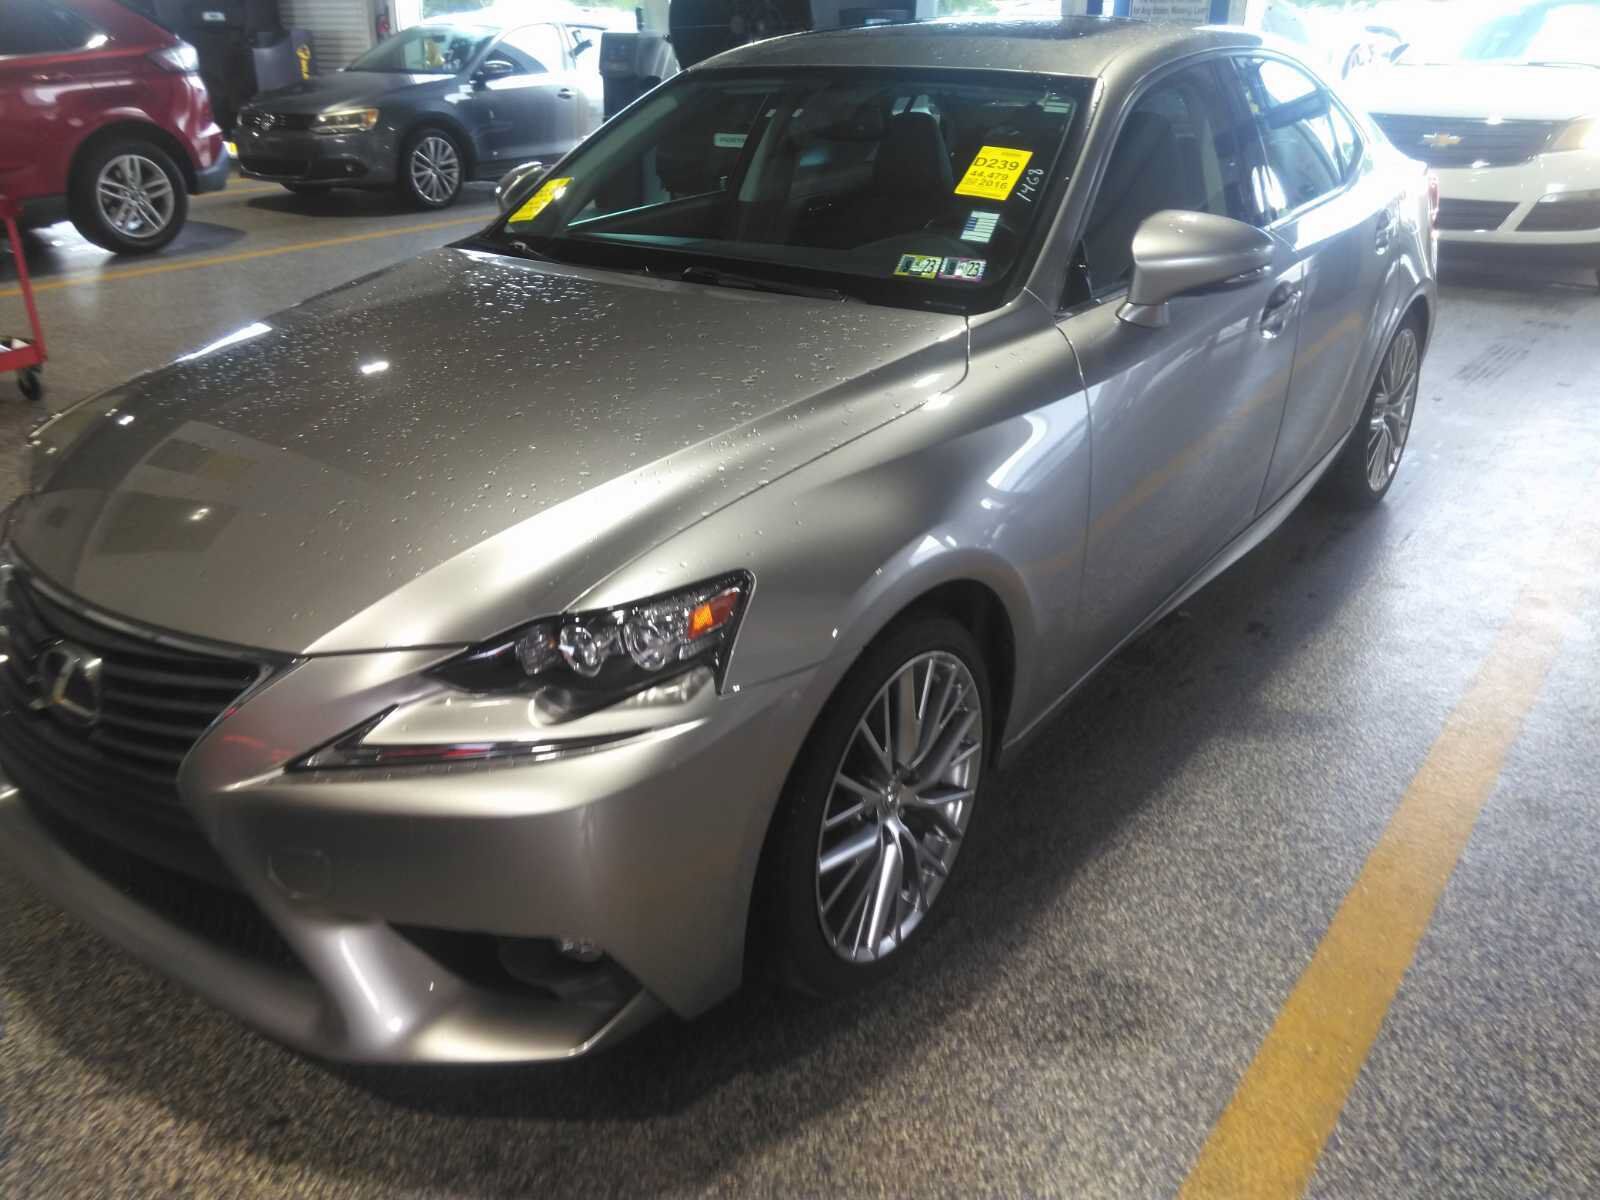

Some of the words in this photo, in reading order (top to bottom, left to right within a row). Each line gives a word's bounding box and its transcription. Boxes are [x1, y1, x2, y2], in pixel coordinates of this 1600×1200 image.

[974, 157, 1019, 171] D239
[978, 178, 1008, 189] 2016
[924, 259, 937, 273] 23
[966, 262, 980, 277] 23
